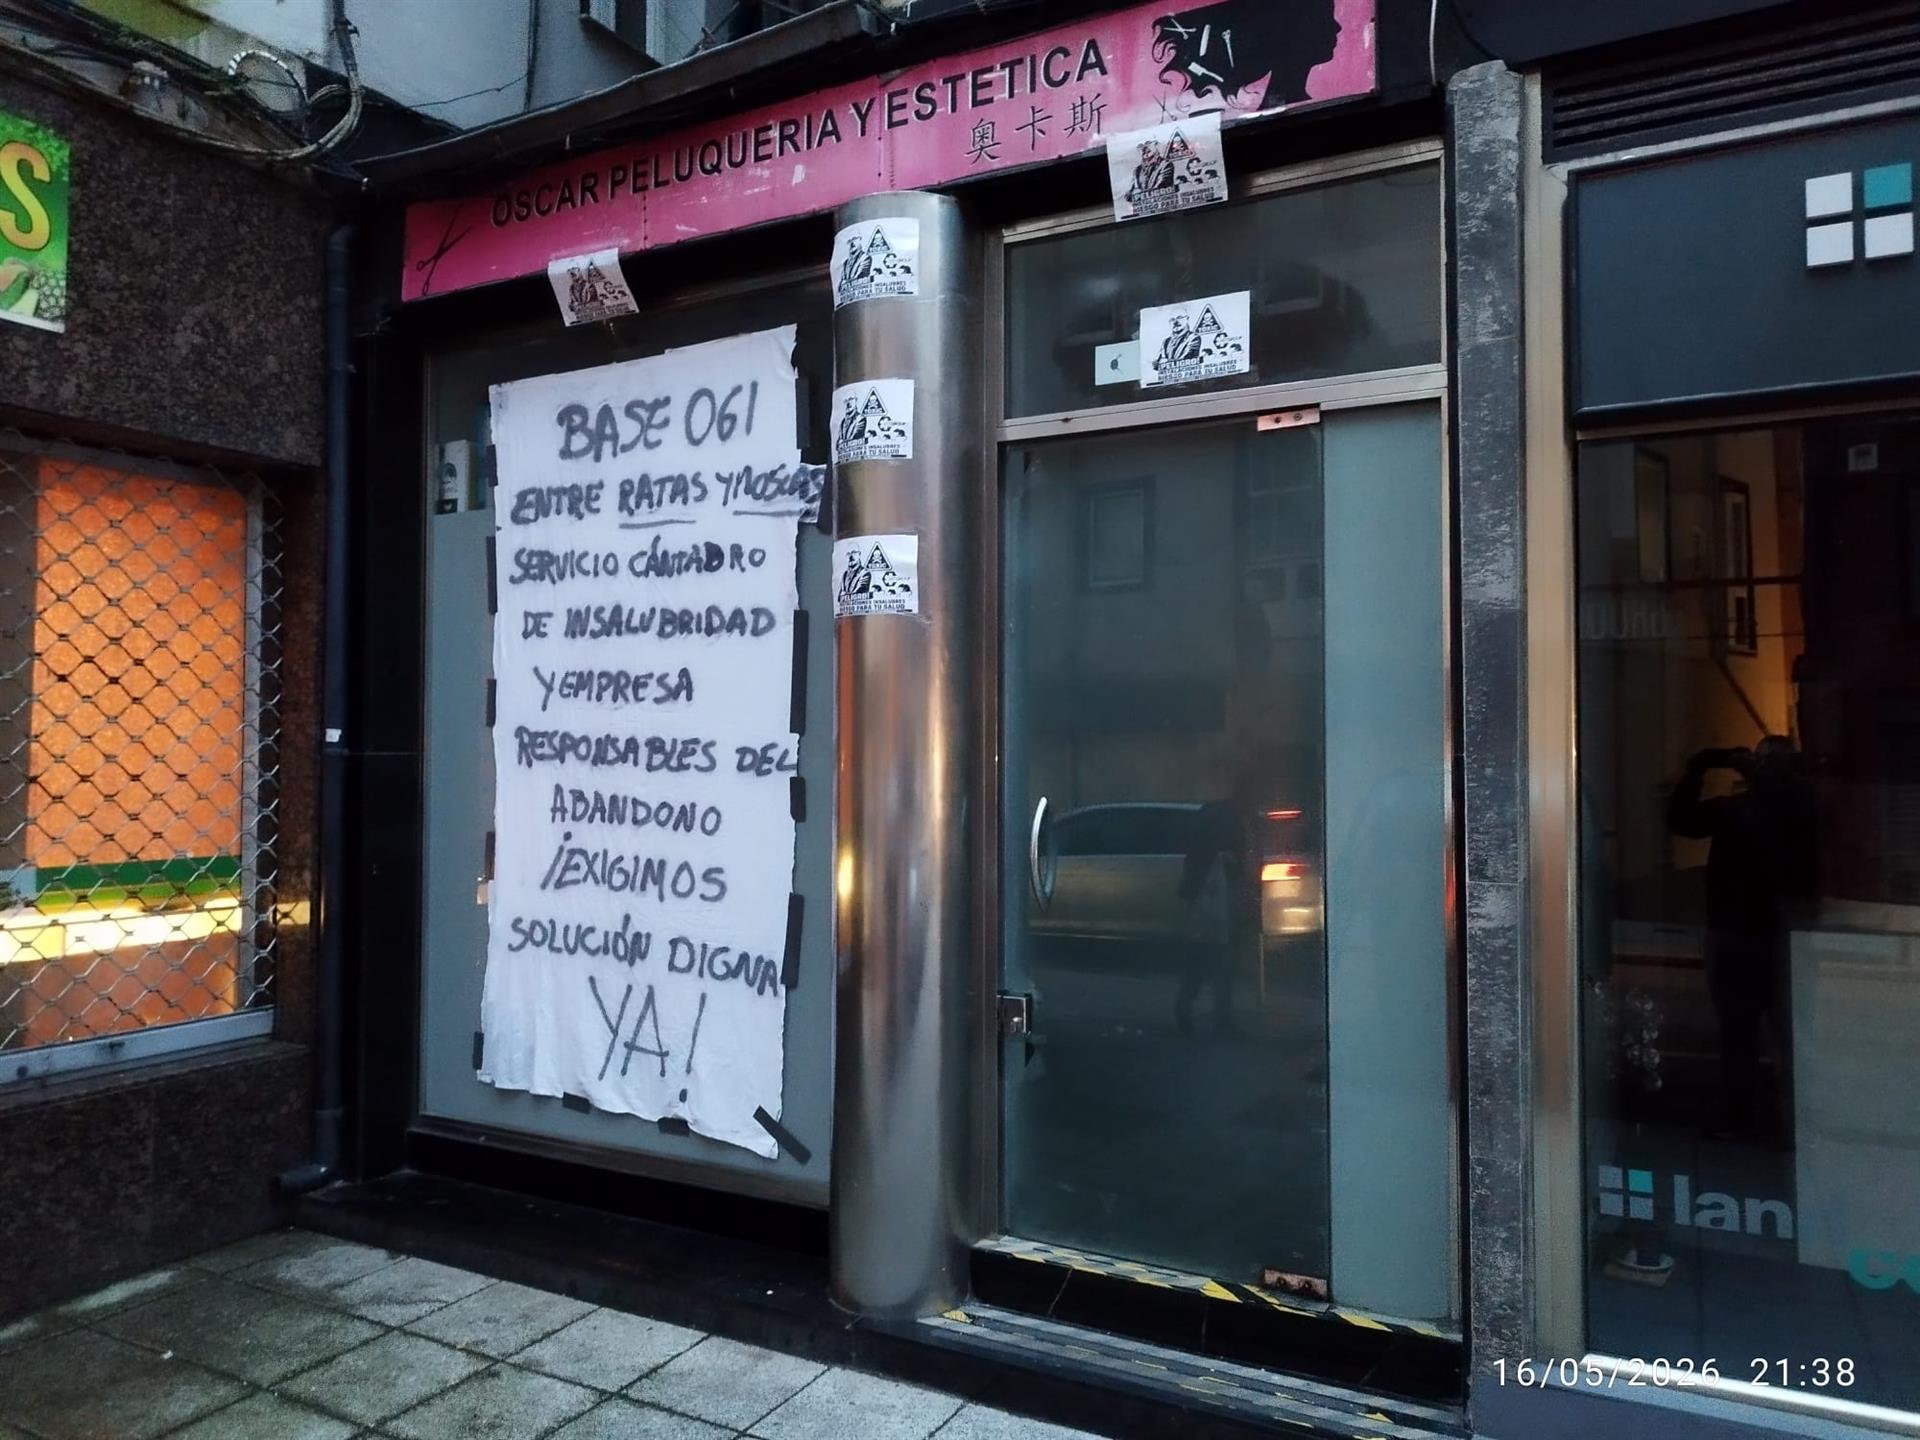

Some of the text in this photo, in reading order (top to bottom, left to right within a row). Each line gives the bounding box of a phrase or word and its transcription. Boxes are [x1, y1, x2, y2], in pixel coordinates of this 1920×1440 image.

[491, 38, 1108, 228] OSCAR PELUQUERIA Y ESTETICA
[964, 92, 1108, 166] 奥卡斯
[1215, 365, 1236, 373] SALUD
[557, 380, 758, 462] BASE 061
[510, 480, 604, 524] ENTRE
[618, 471, 708, 516] RATAS
[509, 547, 619, 585] SERVICIO
[522, 604, 775, 639] DE INSALUBRIDAD
[514, 725, 798, 777] RESPONSABLES DEL
[550, 784, 722, 836] ABANDONO
[540, 831, 727, 902] ¡EXIGIMOS
[508, 913, 778, 997] SOLUCIÓN DIGNA
[1673, 1174, 1794, 1240] lan
